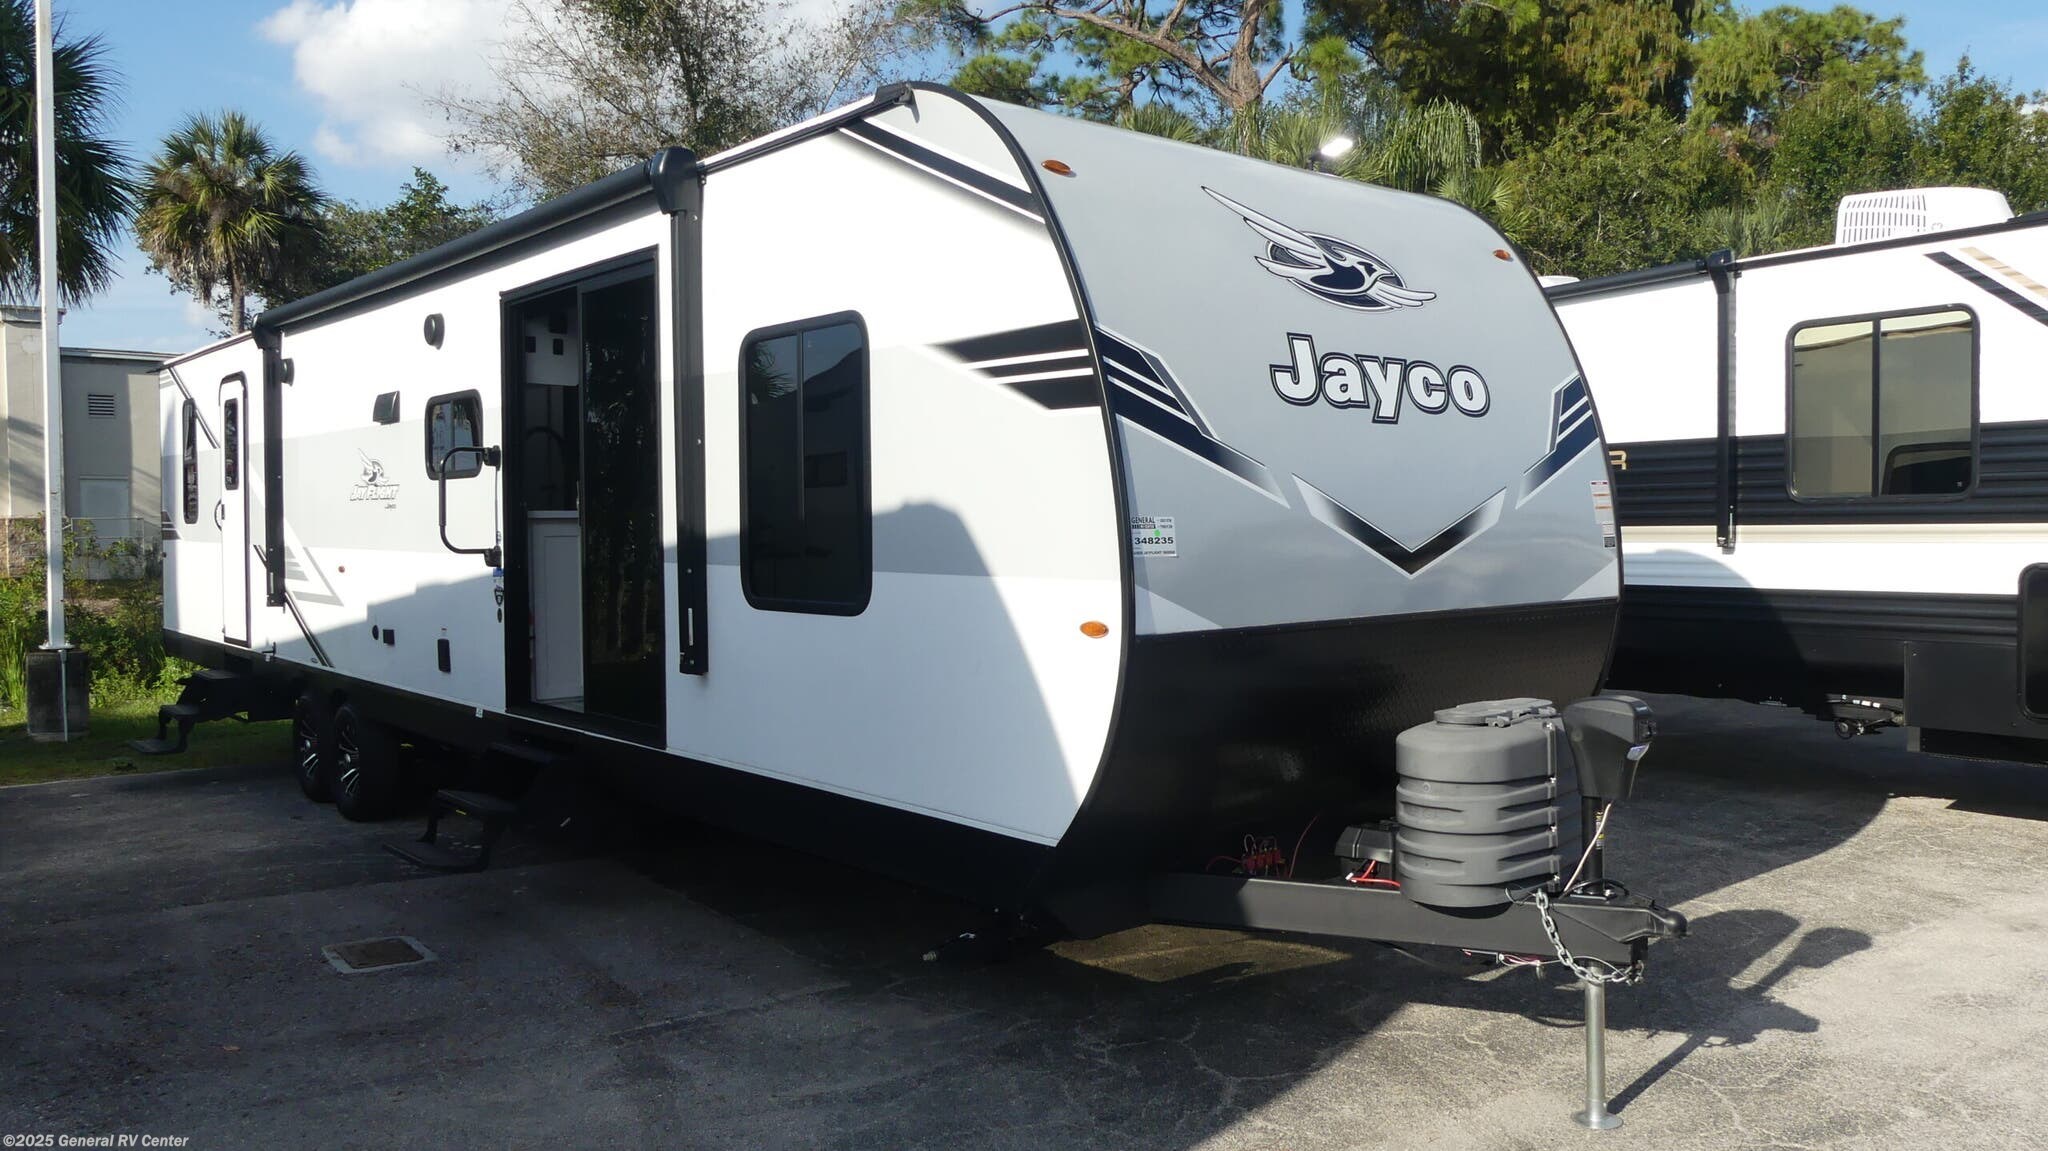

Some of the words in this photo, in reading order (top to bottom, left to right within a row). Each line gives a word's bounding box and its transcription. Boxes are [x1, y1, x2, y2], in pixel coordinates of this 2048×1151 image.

[1269, 331, 1490, 424] Jayco
[350, 484, 368, 501] JAY
[367, 483, 400, 500] FLIGHT
[1134, 536, 1174, 545] 348235
